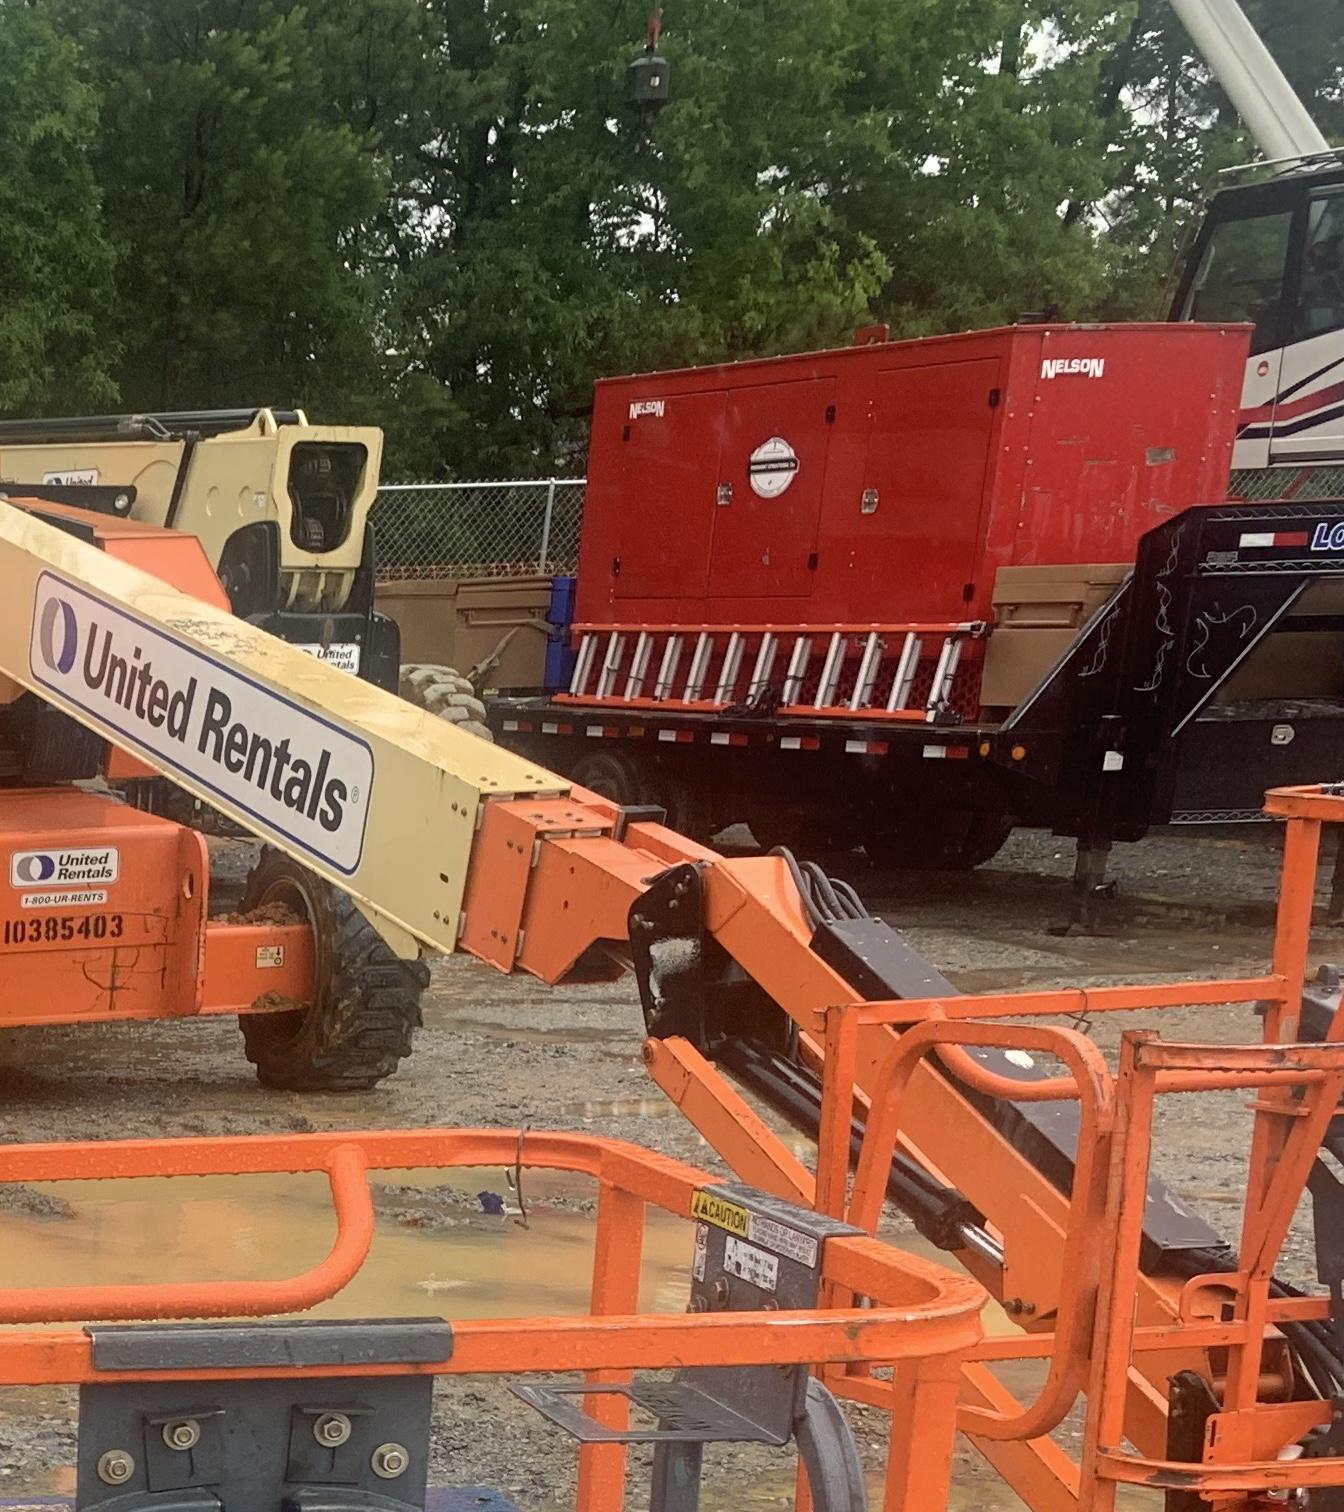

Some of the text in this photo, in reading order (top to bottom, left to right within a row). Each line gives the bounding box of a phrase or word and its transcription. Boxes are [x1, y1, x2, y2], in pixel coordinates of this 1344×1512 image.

[1040, 359, 1104, 379] NELSON
[629, 401, 665, 419] NELSON
[83, 622, 347, 832] United Rentals
[58, 853, 109, 867] United
[57, 867, 113, 880] Rentals
[24, 893, 104, 905] 1-800-UR-RENTS
[708, 1201, 747, 1232] CAUTION
